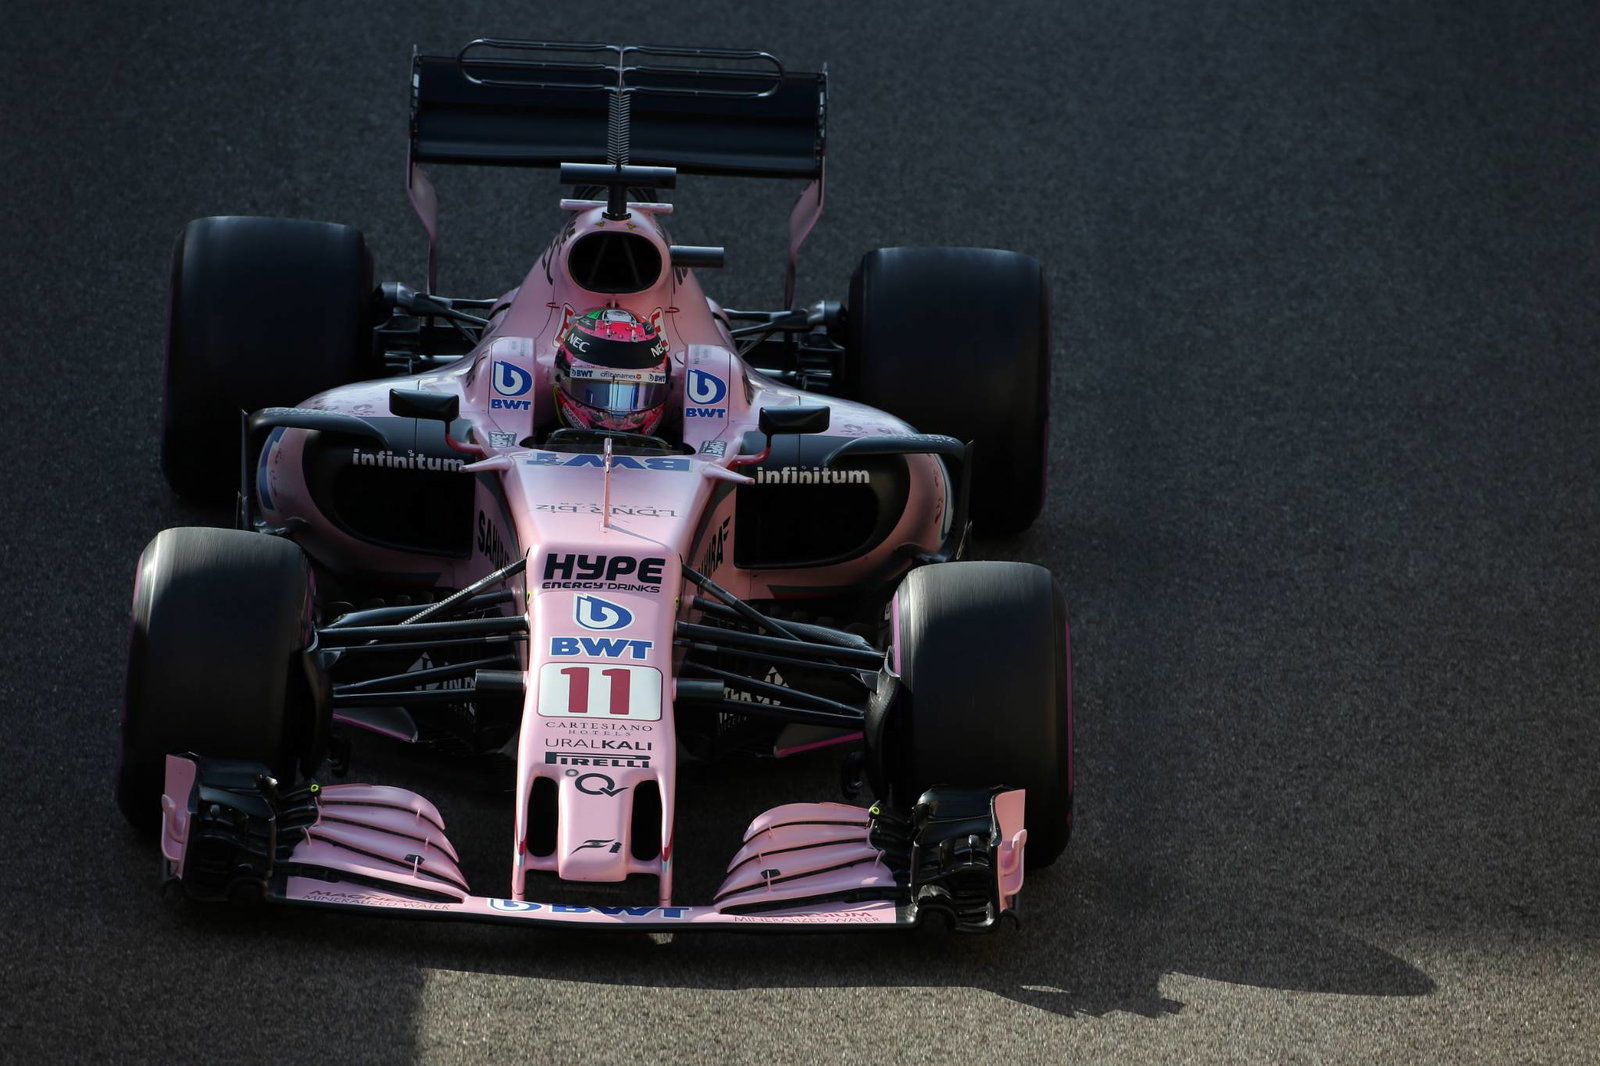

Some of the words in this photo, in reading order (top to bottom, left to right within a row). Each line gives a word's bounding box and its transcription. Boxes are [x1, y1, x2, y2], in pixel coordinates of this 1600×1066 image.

[567, 333, 590, 353] NEC
[491, 399, 531, 410] BWT
[685, 408, 726, 418] BWT
[352, 448, 465, 472] infinitum
[757, 467, 870, 484] infinitum
[543, 553, 666, 584] HYPE
[541, 581, 606, 589] ENERGY
[607, 582, 661, 593] DRINKS
[551, 637, 653, 660] BWT
[560, 667, 631, 715] 11
[545, 722, 653, 731] CARTESIANO
[545, 738, 652, 751] URALKALI
[545, 752, 651, 768] PIRELLI
[551, 904, 692, 919] BWT
